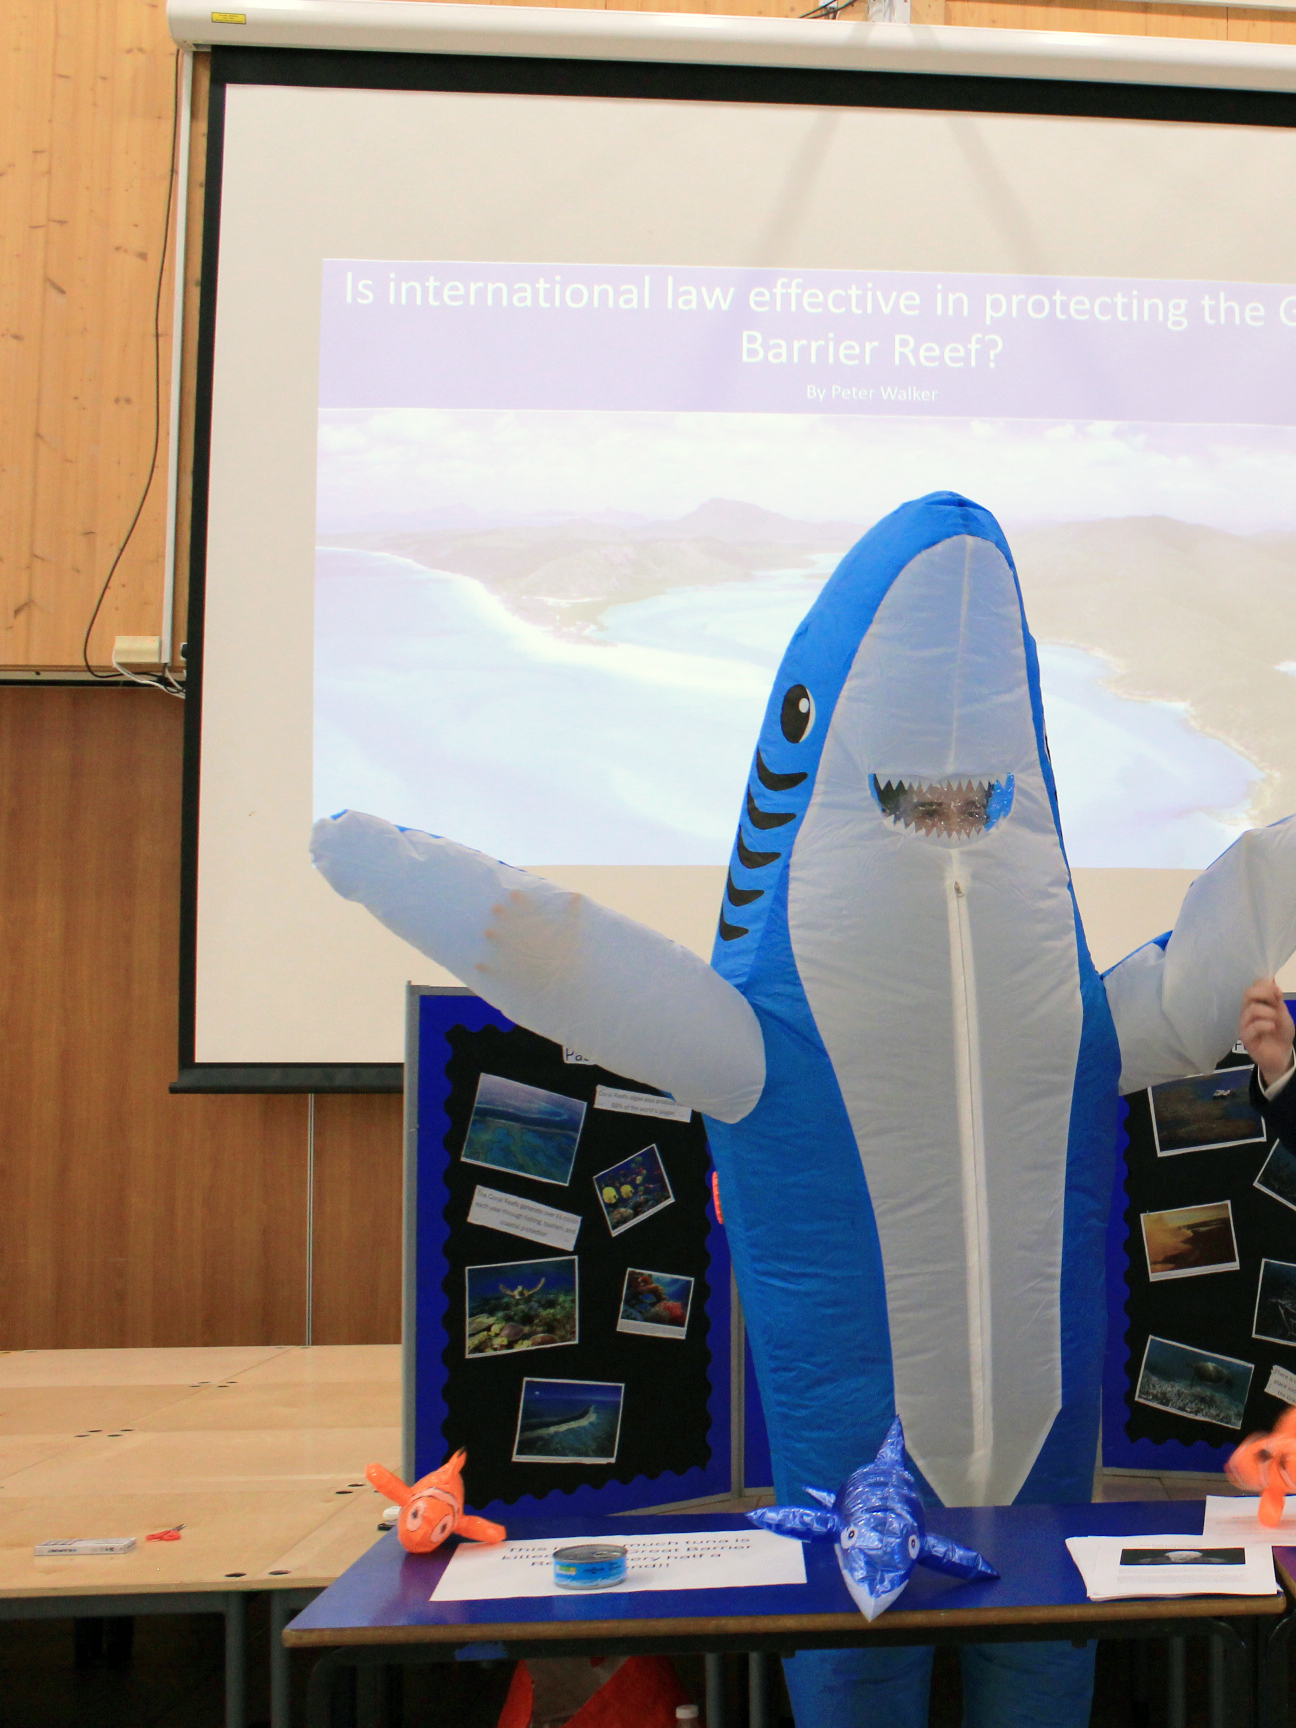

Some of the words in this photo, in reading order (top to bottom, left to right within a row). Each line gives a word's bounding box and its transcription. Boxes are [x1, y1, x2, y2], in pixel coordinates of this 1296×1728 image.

[345, 272, 375, 305] Is
[389, 273, 651, 311] international
[667, 276, 734, 312] law
[748, 277, 921, 316] effective
[936, 283, 969, 317] in
[985, 288, 1189, 331] protecting
[1201, 291, 1267, 327] the
[742, 330, 879, 365] Barrier
[894, 334, 1004, 368] Reef?
[806, 385, 826, 401] By
[831, 385, 875, 401] Peter
[880, 386, 938, 402] Walker
[566, 1048, 589, 1062] Pa
[686, 1544, 752, 1552] Barrier
